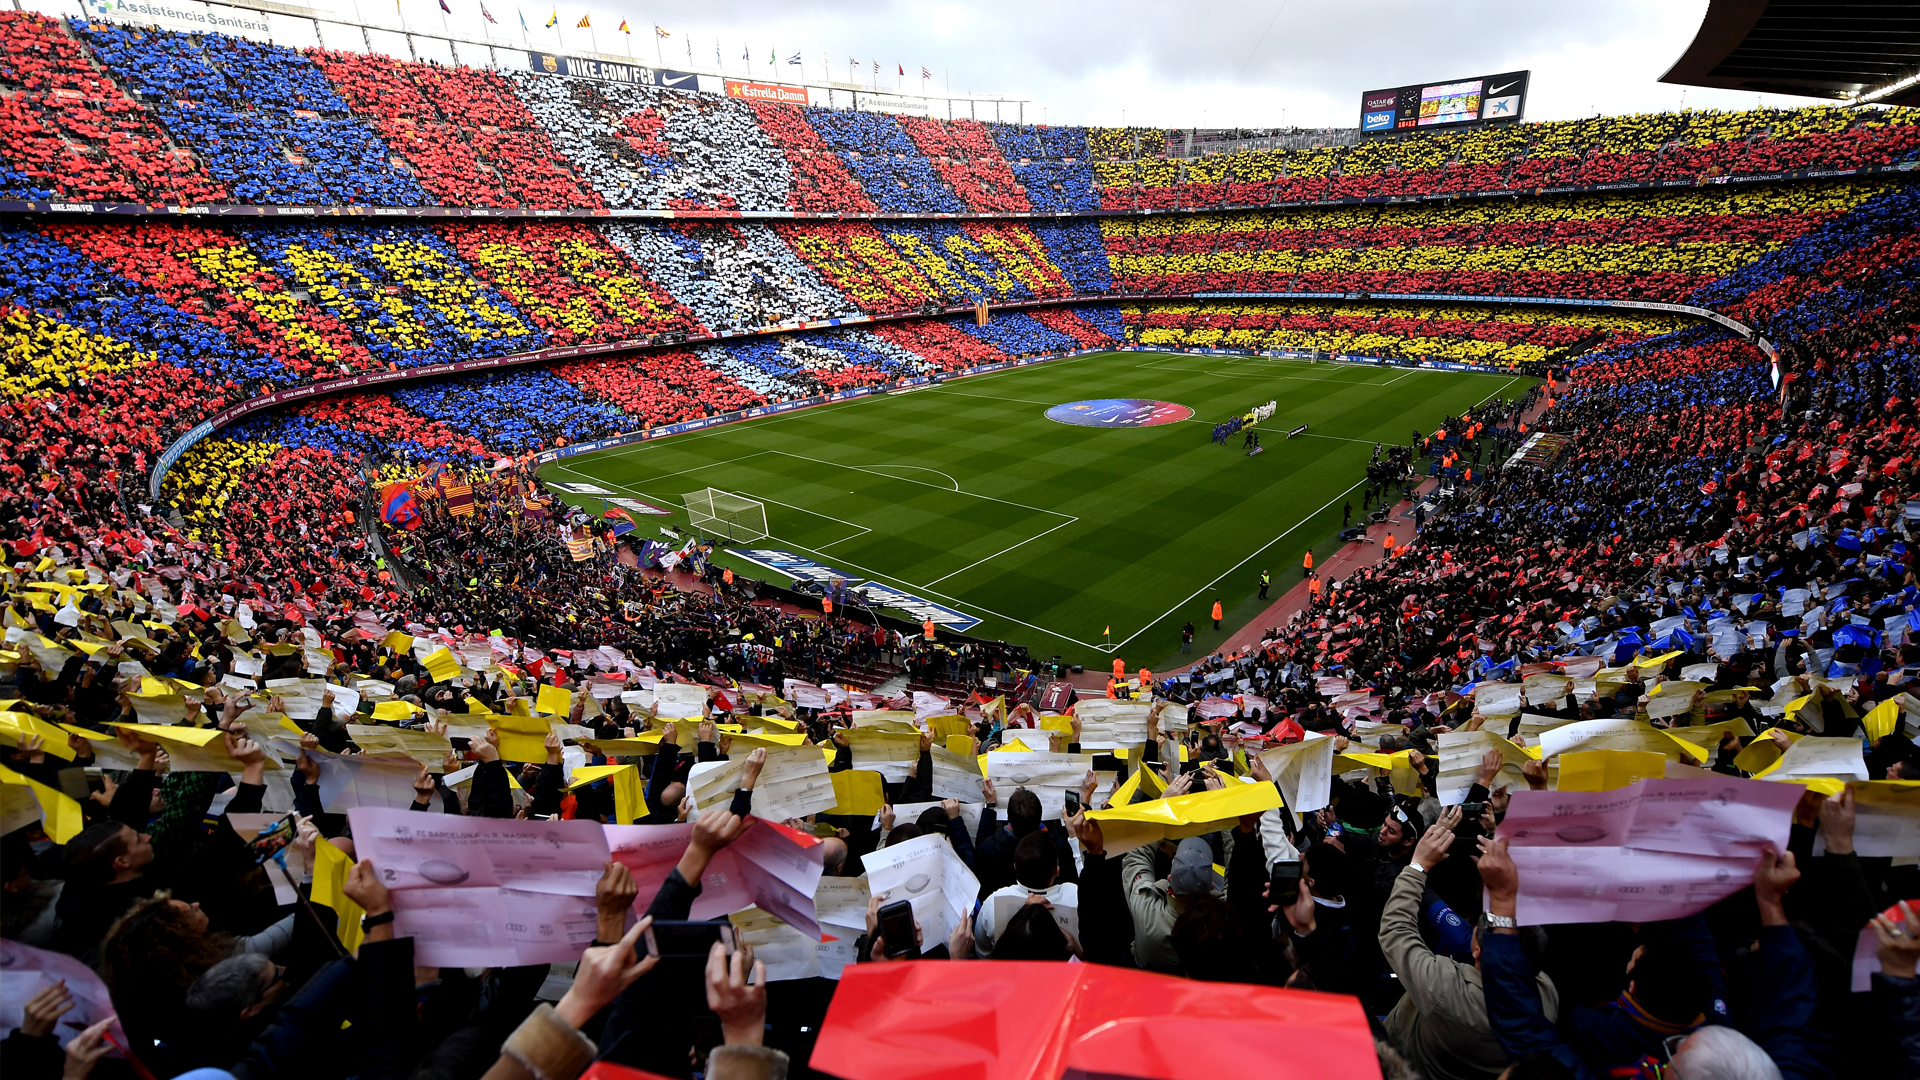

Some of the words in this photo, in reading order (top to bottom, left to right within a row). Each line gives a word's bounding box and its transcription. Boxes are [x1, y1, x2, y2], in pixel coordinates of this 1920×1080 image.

[117, 0, 206, 23] Assistència
[207, 13, 270, 32] Sanitària
[566, 58, 656, 85] NIKE.COM/FCB
[742, 83, 777, 99] Estrella
[778, 87, 806, 102] Damm
[1367, 98, 1386, 106] QATAR
[1367, 113, 1390, 124] beko
[1398, 120, 1417, 129] 16:12
[1733, 174, 1783, 182] FCBARCELONA.COM
[50, 203, 95, 213] NIKE.COM/FCB
[1643, 302, 1666, 310] KONAMI
[1666, 304, 1686, 312] KONAMI
[431, 365, 450, 373] AIRWAYS
[382, 372, 401, 380] AIRWAYS
[322, 383, 335, 391] QATAR
[416, 830, 427, 838] FC
[428, 831, 480, 839] BARCELONA
[913, 844, 942, 857] BARCELONA
[383, 869, 397, 882] 2
[884, 890, 892, 901] 2
